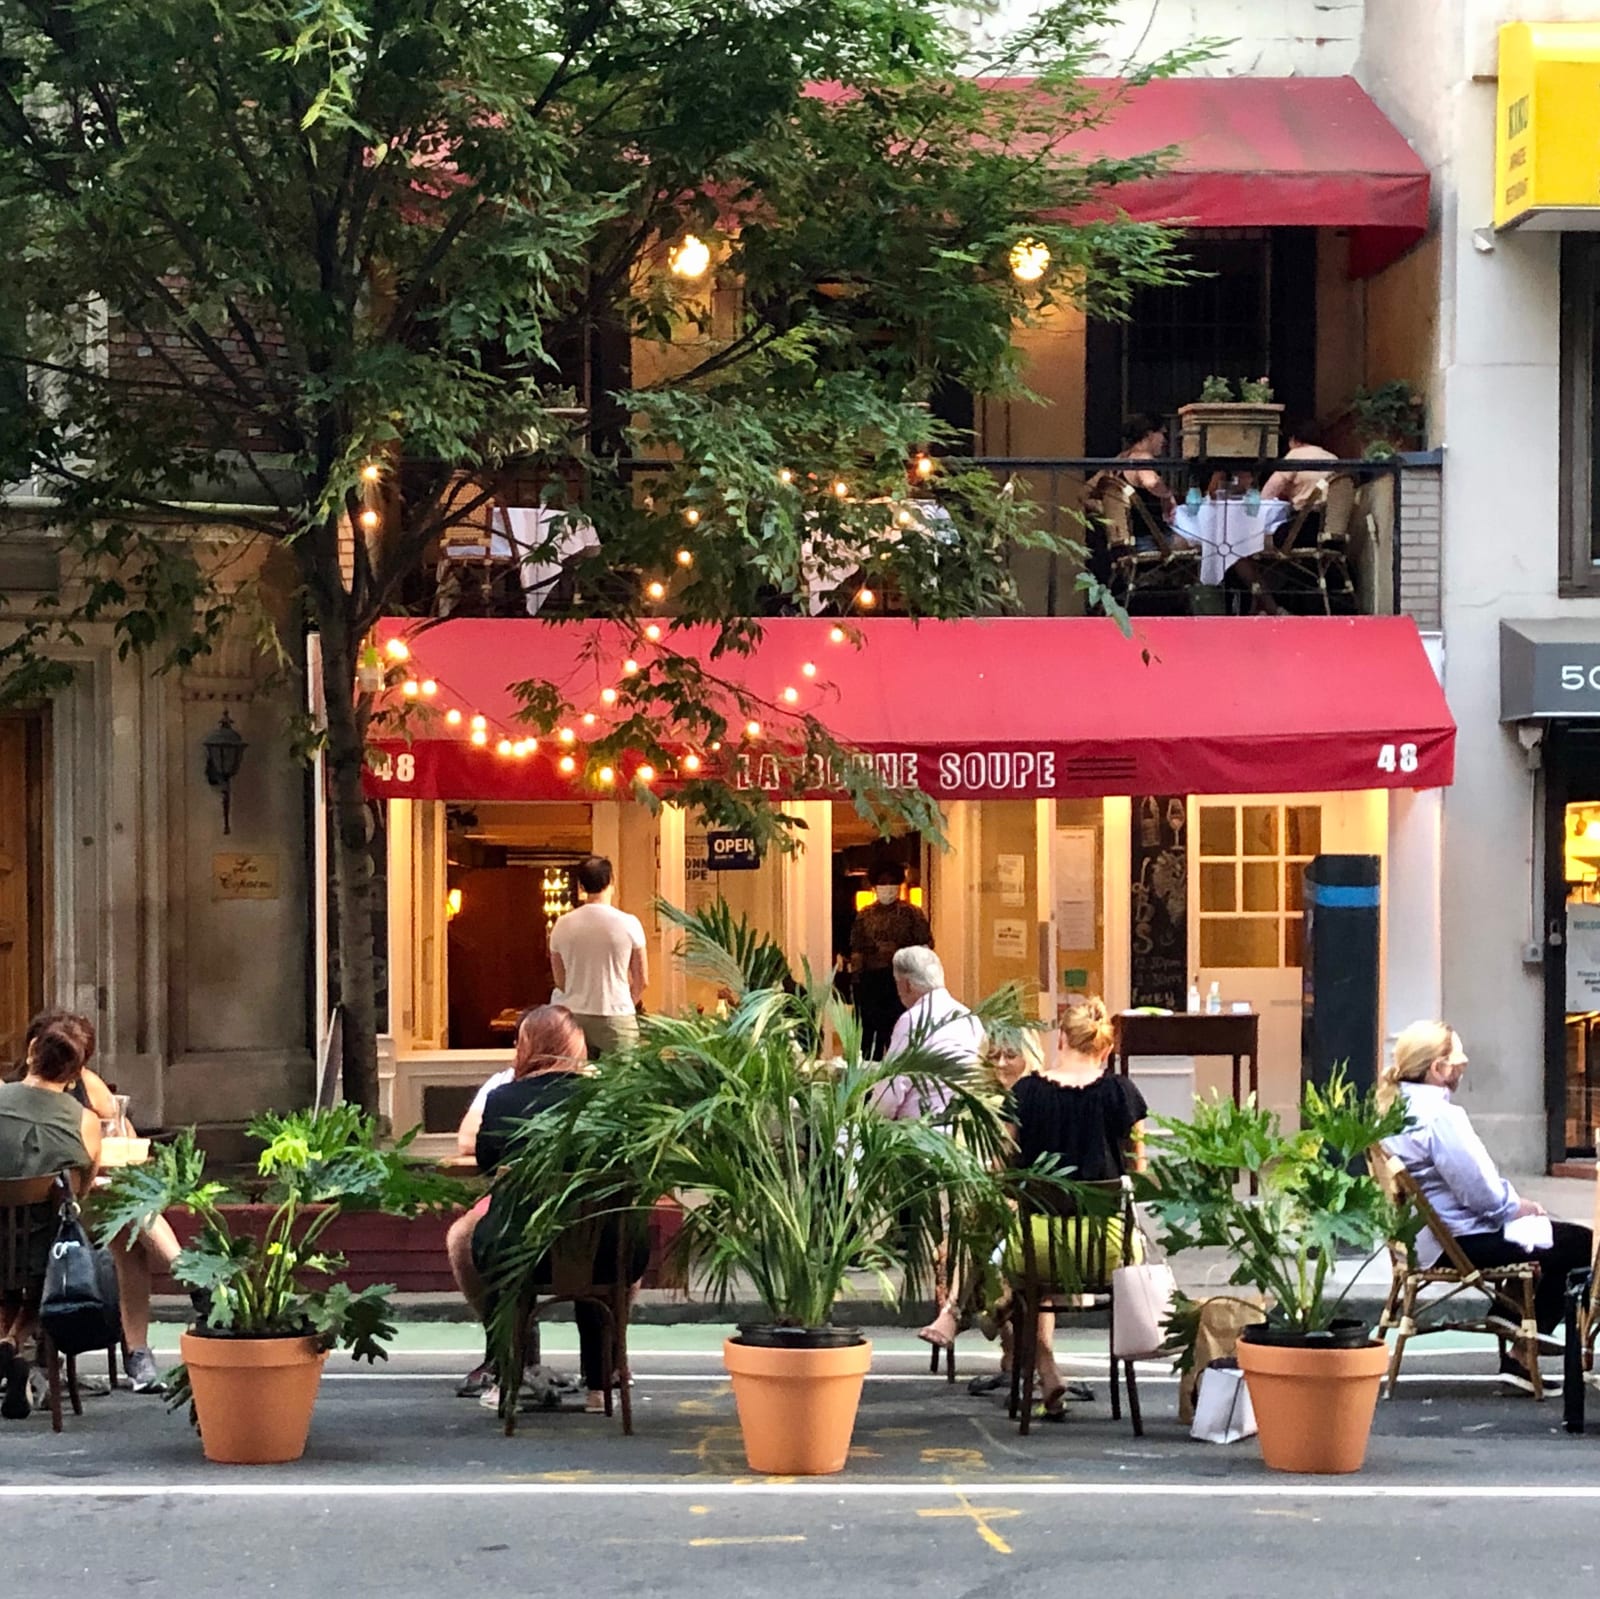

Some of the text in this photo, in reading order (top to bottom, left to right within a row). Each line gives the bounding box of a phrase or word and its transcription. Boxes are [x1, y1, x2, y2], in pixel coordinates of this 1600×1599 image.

[374, 753, 415, 782] 48
[939, 751, 1056, 790] SOUPE
[1377, 743, 1418, 772] 48
[714, 838, 754, 854] OPEN
